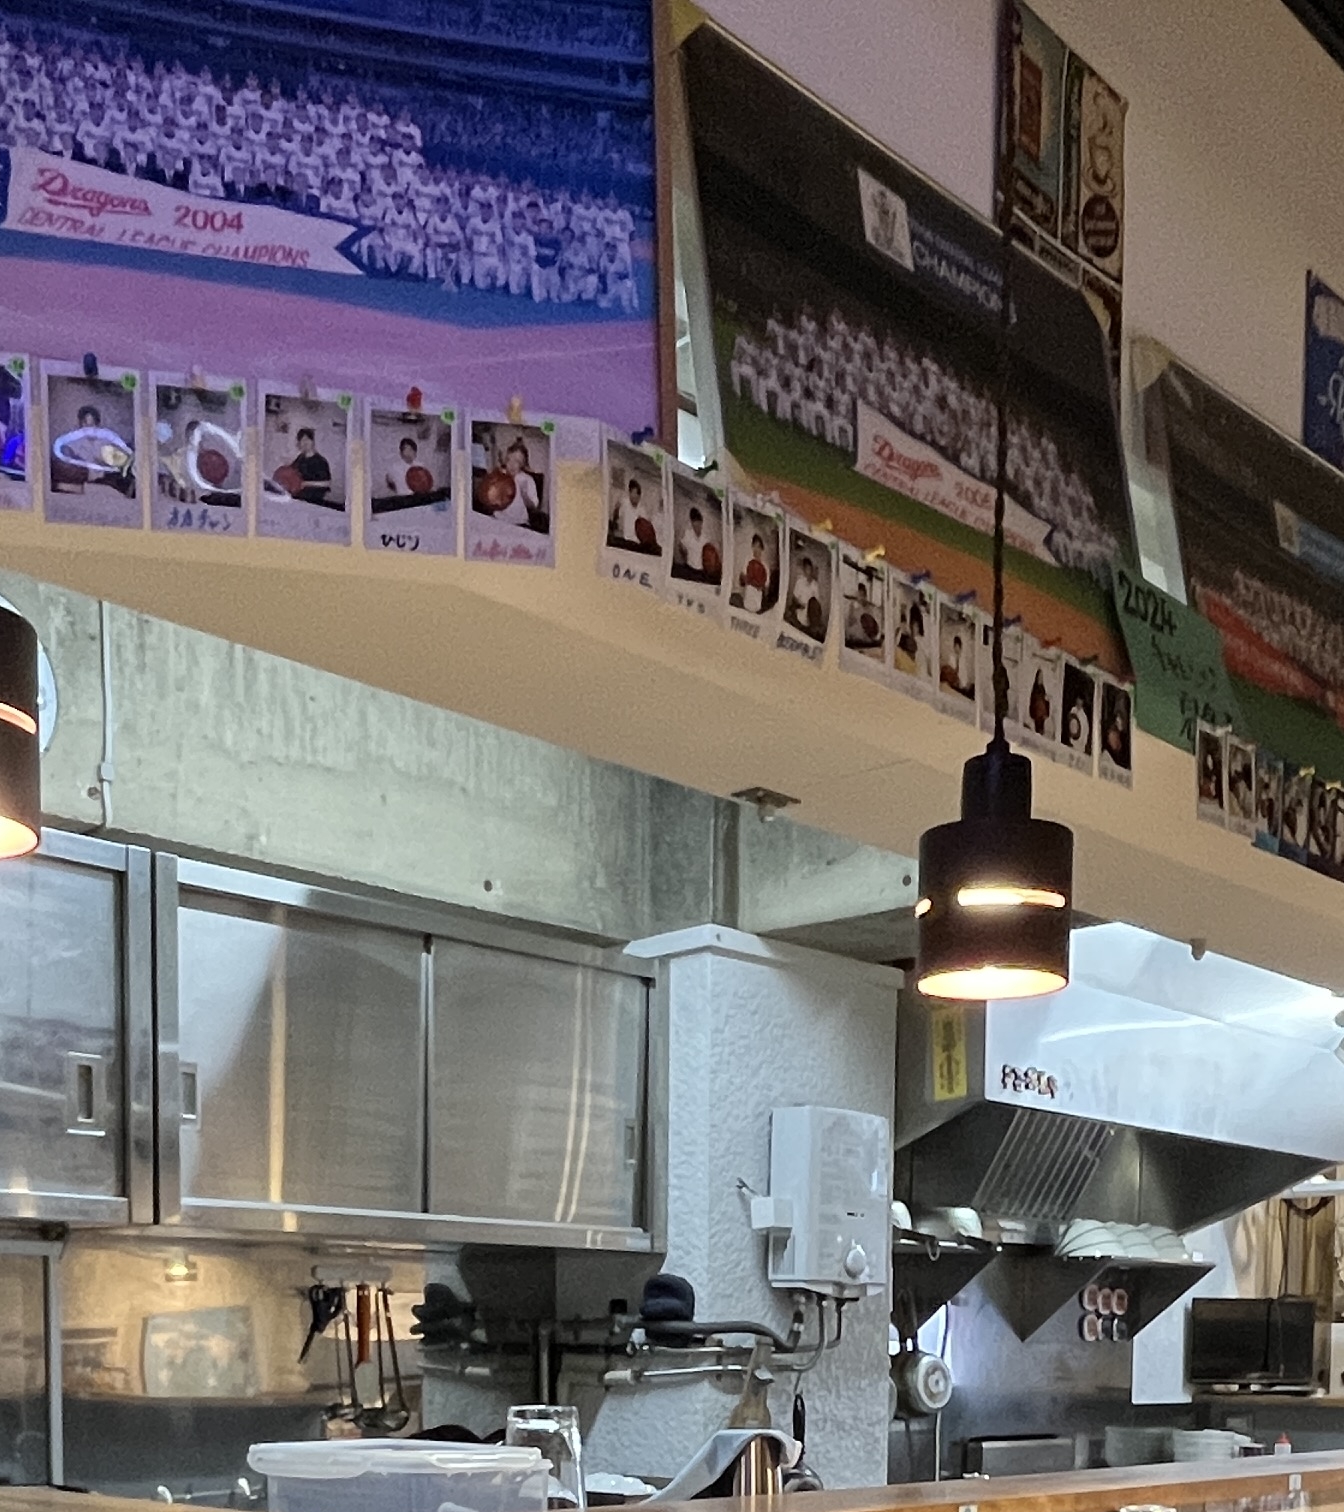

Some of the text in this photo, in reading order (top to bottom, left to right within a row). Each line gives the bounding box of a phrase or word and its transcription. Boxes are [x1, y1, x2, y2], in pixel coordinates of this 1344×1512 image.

[33, 168, 244, 234] Dragons 2004
[17, 206, 106, 239] CENTRAL
[381, 533, 421, 552] ひじり
[612, 563, 652, 589] ONE
[1118, 570, 1178, 638] 2024
